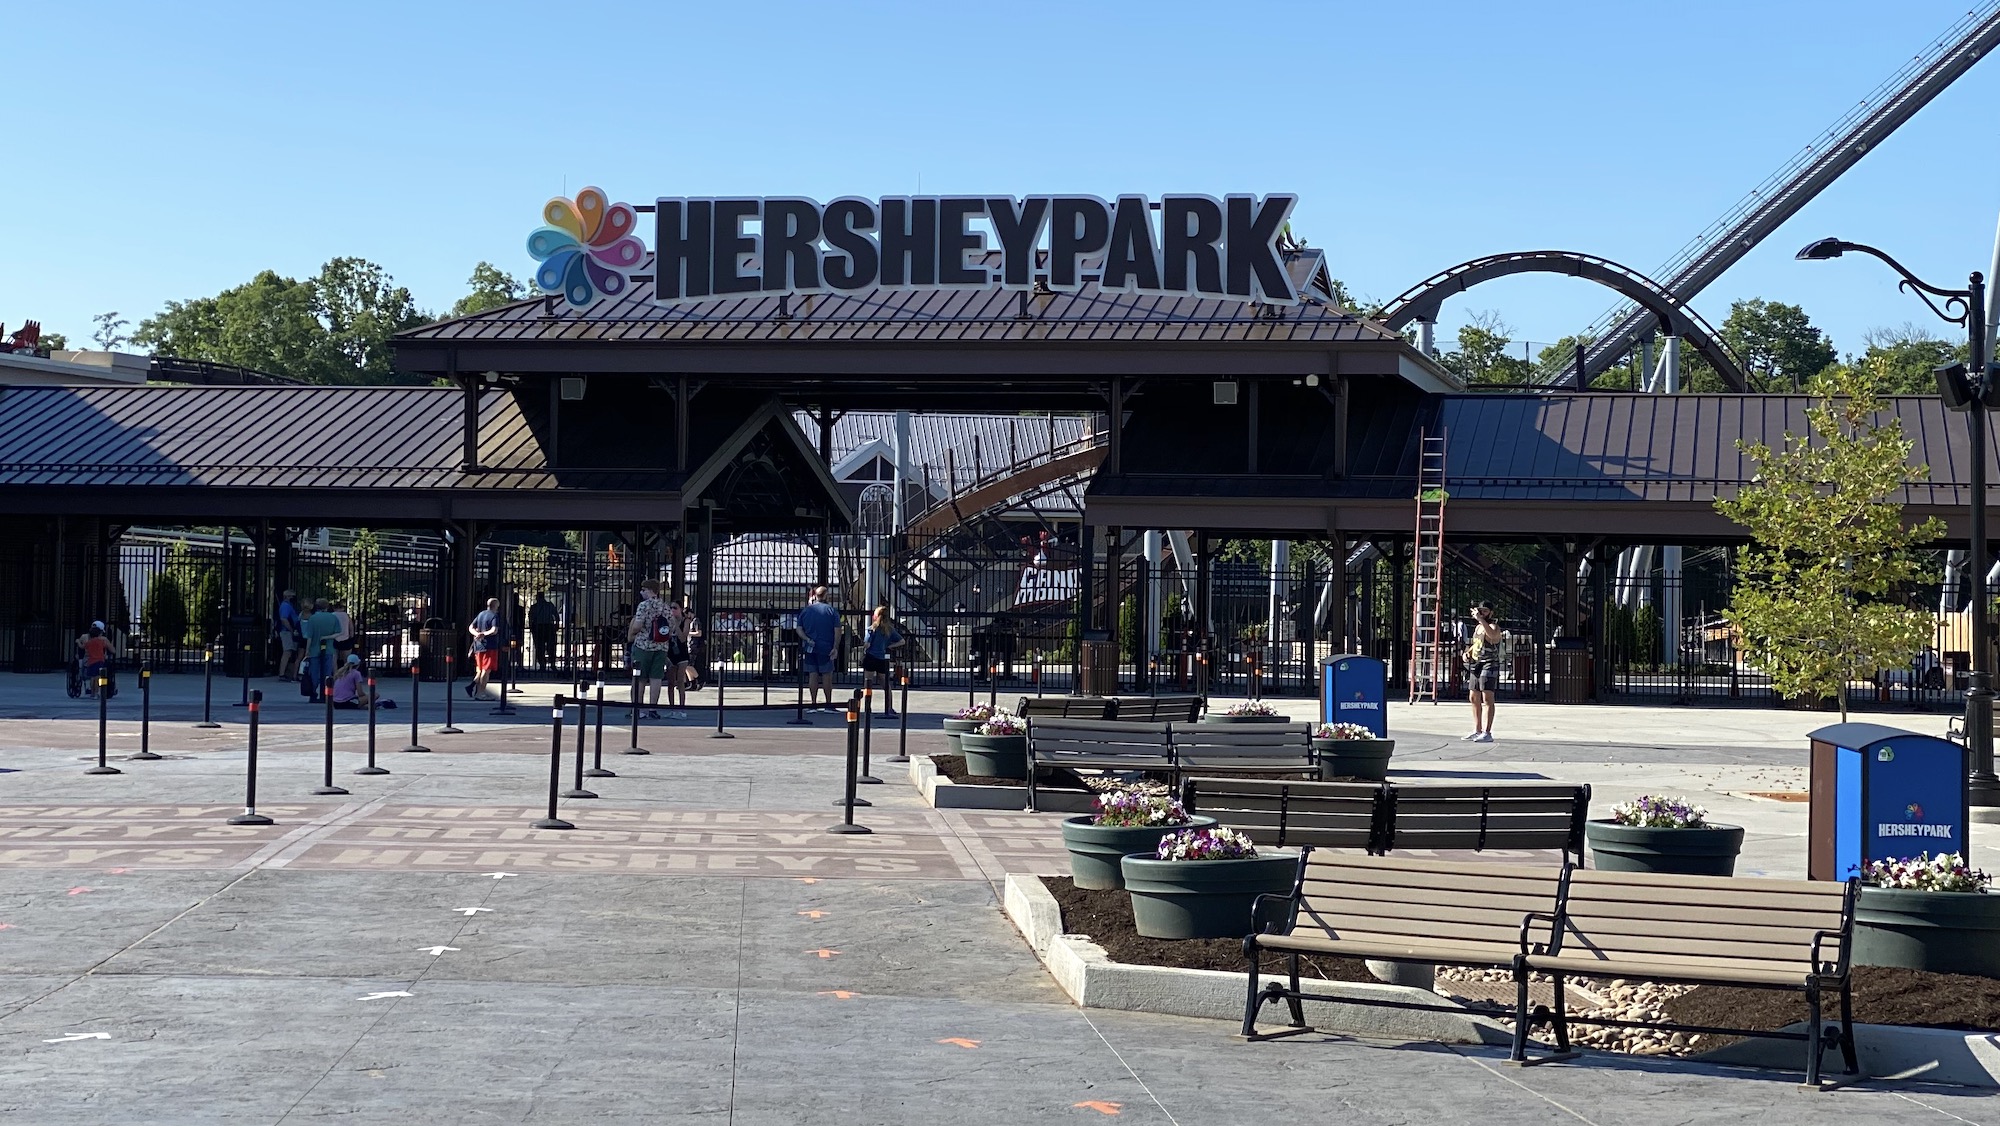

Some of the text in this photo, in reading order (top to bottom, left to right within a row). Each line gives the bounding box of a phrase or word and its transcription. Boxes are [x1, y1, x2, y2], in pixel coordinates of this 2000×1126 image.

[655, 195, 1297, 303] HERSHEYPARK
[1020, 566, 1082, 588] CAND
[1340, 702, 1379, 710] HERSHEYPARK
[1878, 823, 1952, 838] HERSHEYPARK
[330, 849, 921, 873] HERSHEY'S
